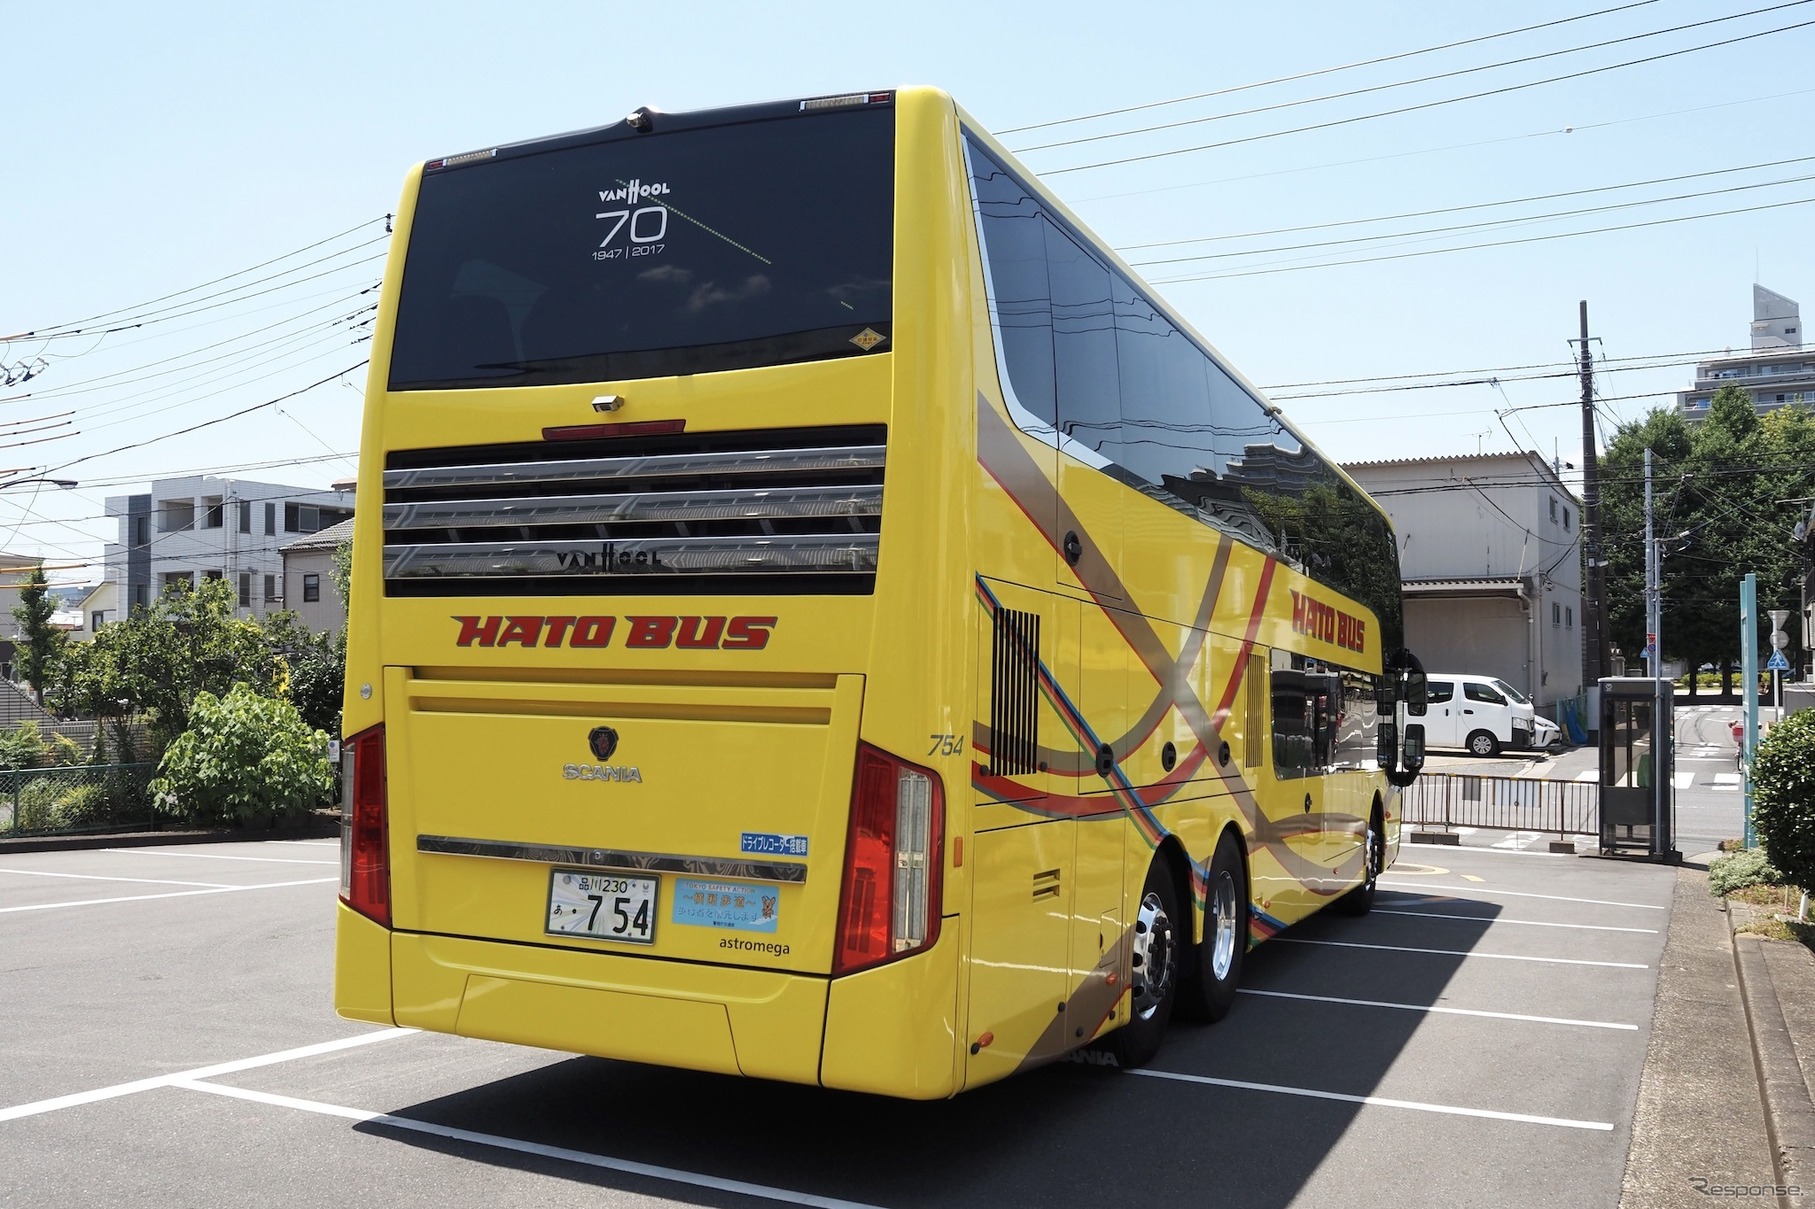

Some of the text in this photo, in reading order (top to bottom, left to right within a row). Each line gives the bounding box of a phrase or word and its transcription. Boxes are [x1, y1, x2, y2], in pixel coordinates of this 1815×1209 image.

[596, 206, 667, 247] 70
[1289, 588, 1365, 654] HATO BUS
[450, 615, 779, 650] HATO BUS
[927, 734, 964, 756] 754
[563, 763, 643, 783] SCANIA
[686, 882, 706, 890] TOKYO
[708, 884, 730, 892] SAFETY
[719, 938, 790, 957] astromega
